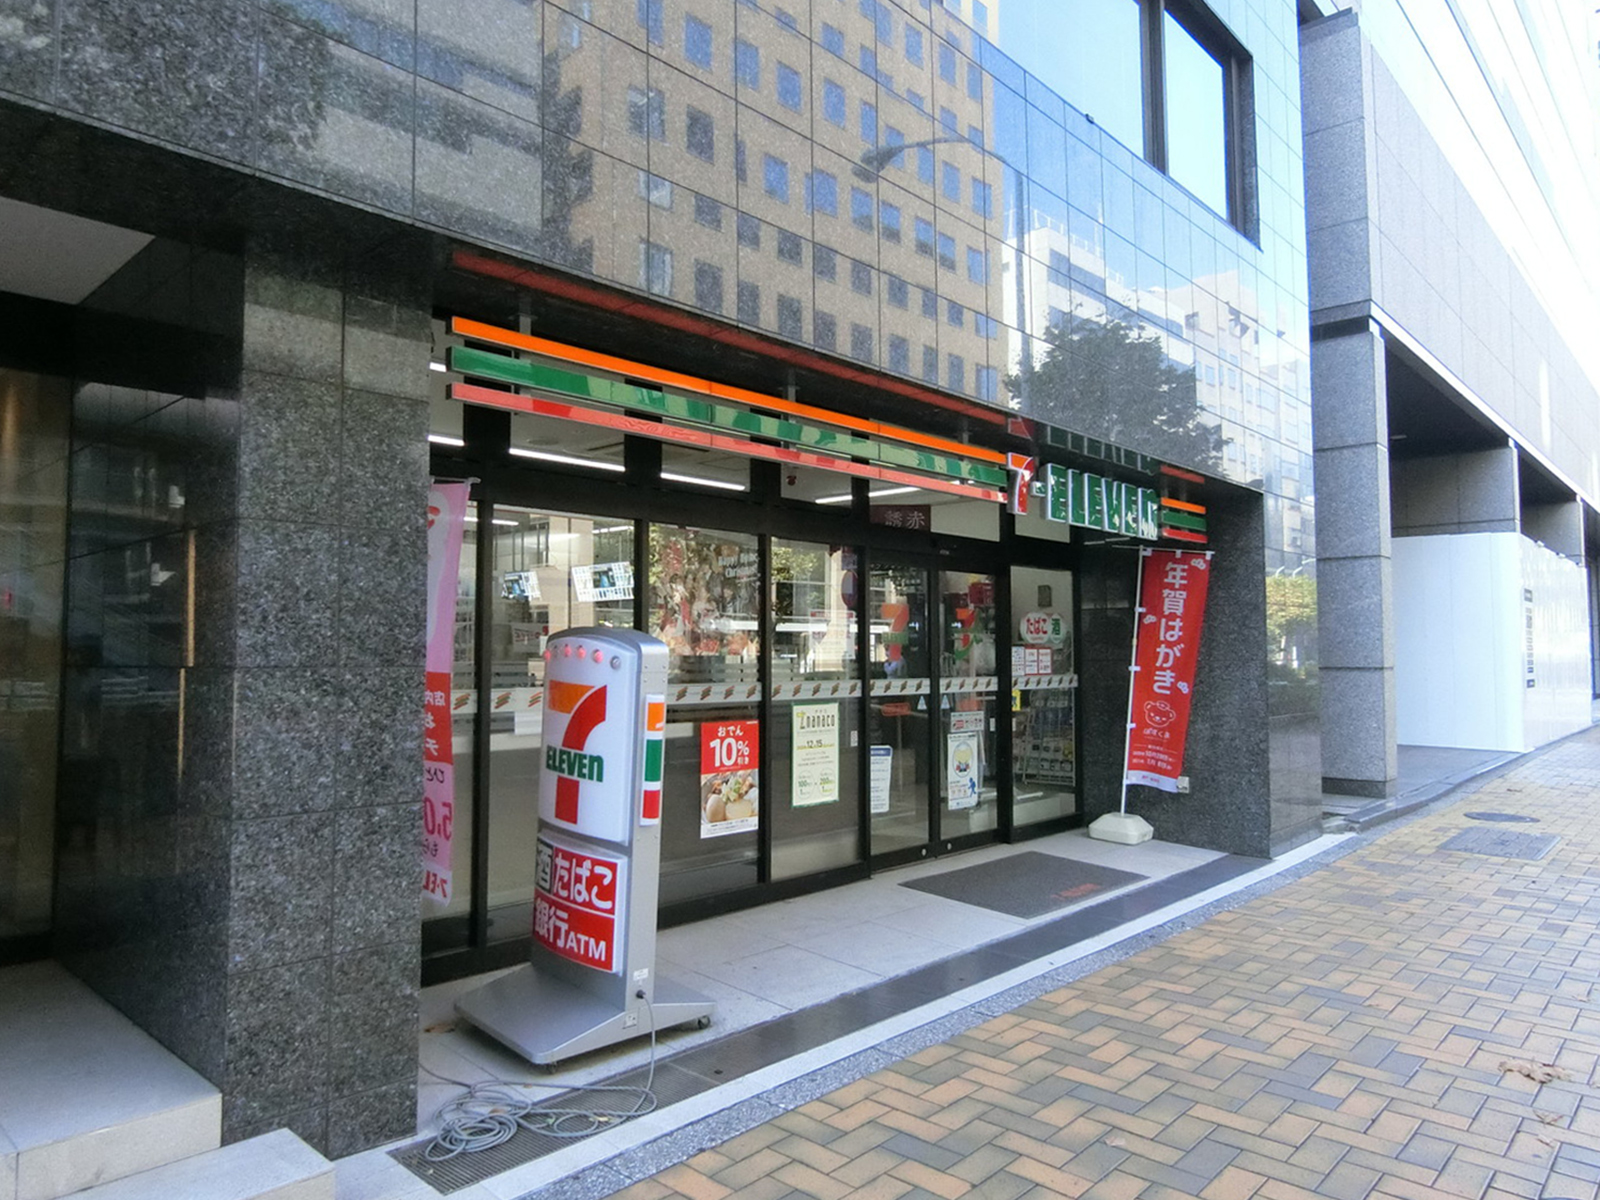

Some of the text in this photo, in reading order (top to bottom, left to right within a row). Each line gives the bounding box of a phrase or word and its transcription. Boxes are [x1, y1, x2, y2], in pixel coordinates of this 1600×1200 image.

[1026, 617, 1048, 635] たばこ
[1153, 562, 1188, 695] 年賀はがき
[717, 726, 743, 737] おでん
[709, 737, 750, 768] 10%
[554, 852, 613, 909] たばこ
